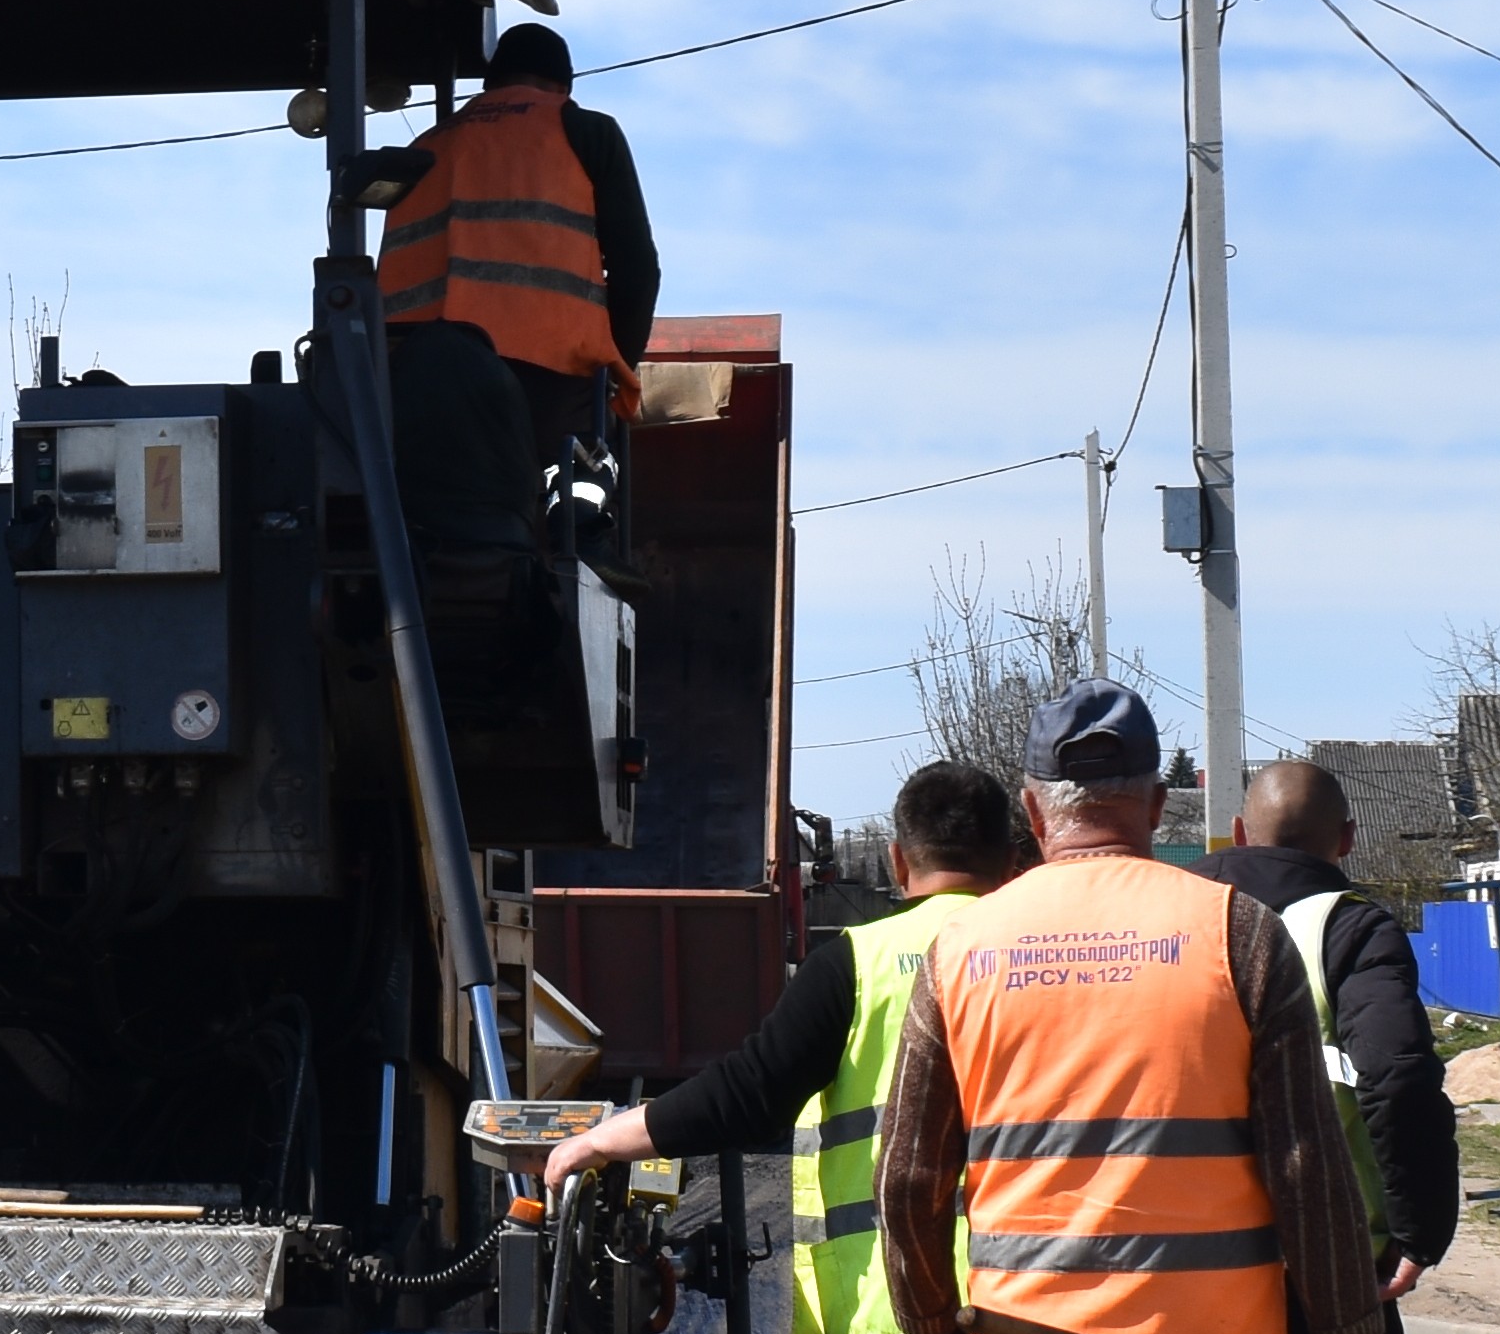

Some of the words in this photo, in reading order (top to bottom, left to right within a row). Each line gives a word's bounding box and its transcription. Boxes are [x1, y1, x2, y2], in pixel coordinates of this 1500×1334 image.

[1017, 930, 1138, 945] ФИЛИАЛ
[968, 949, 997, 984] КУП
[1005, 968, 1070, 992] ДРСУ
